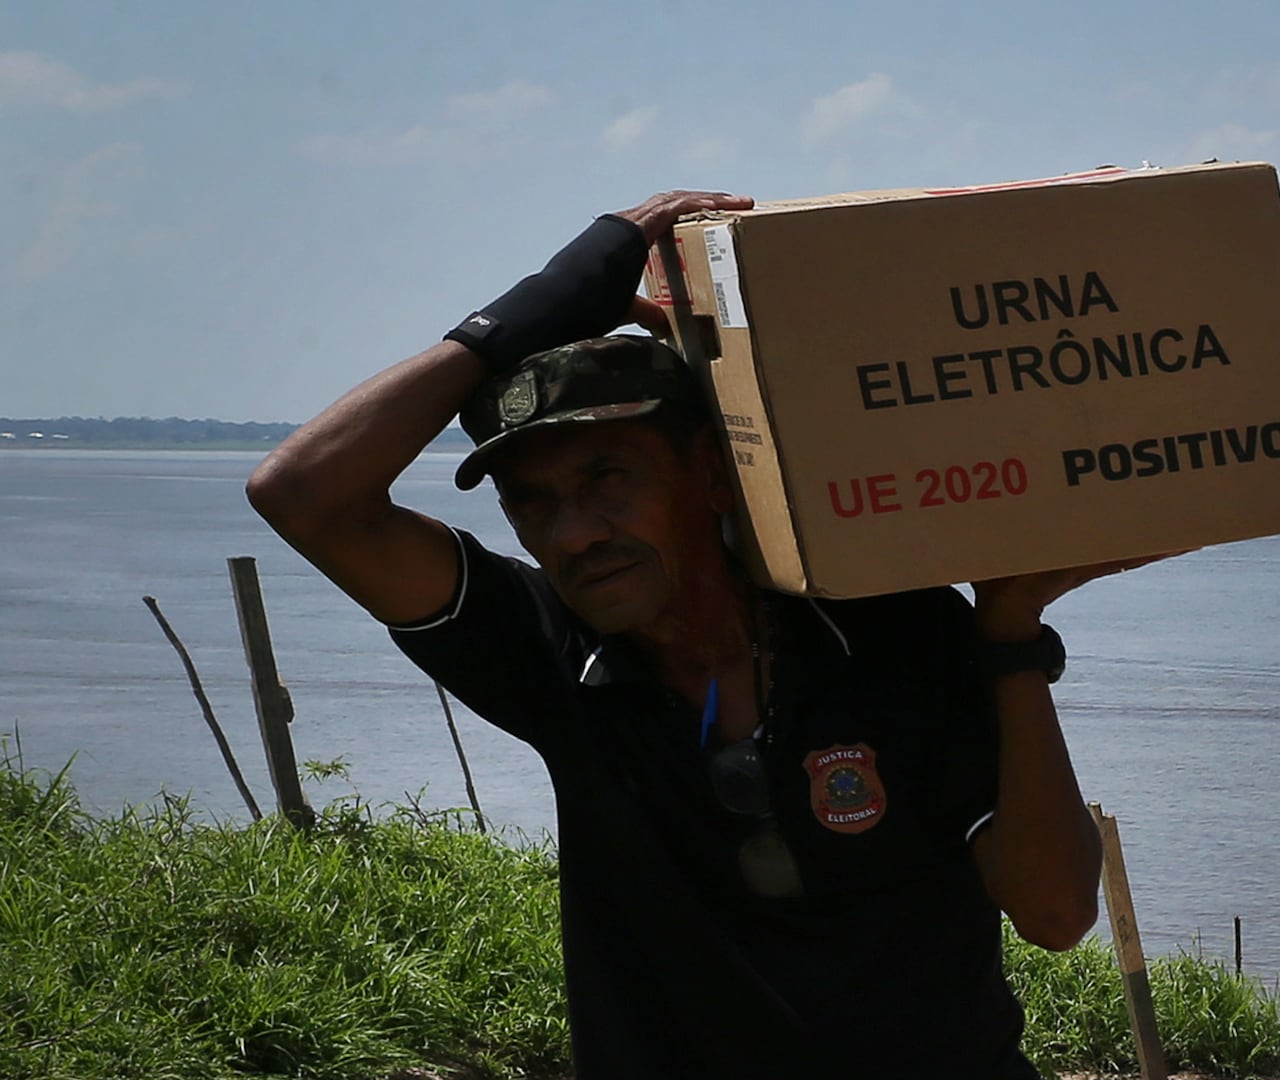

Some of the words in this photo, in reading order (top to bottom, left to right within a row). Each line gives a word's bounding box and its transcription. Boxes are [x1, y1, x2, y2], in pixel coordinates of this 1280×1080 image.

[950, 271, 1120, 330] URNA
[855, 323, 1231, 411] ELETRÔNICA
[827, 473, 903, 518] UE
[915, 458, 1028, 507] 2020
[828, 808, 877, 822] ELEITORAL
